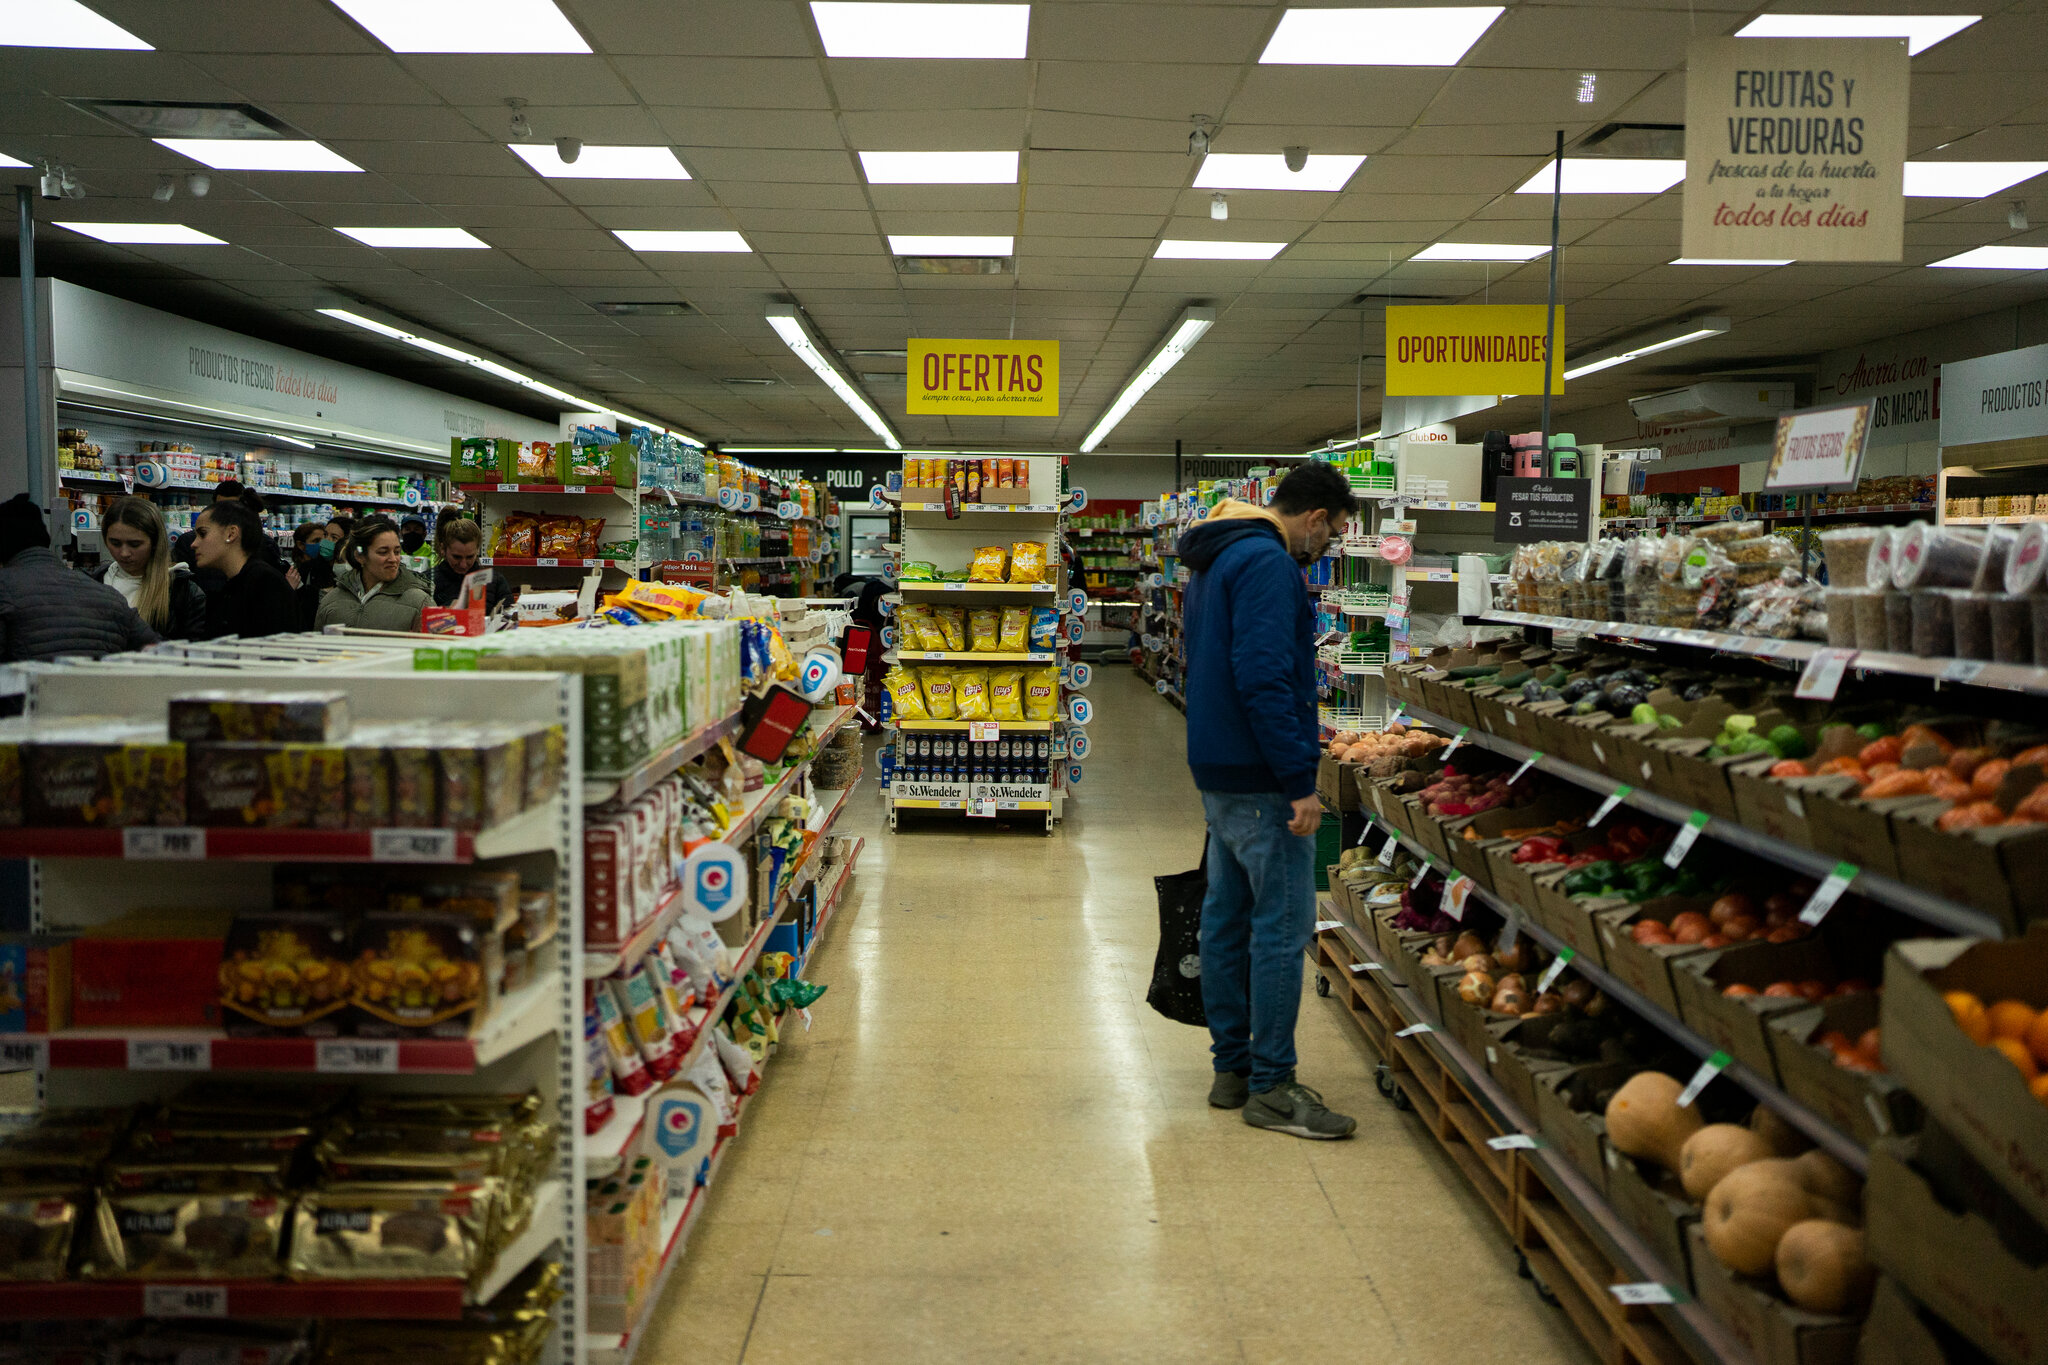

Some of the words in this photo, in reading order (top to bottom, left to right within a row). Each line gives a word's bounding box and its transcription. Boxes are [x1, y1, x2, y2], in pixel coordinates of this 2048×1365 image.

[1735, 70, 1834, 108] FRUTAS
[1842, 78, 1855, 108] Y
[1728, 117, 1864, 155] VERDURAS
[1707, 160, 1768, 185] frescas
[1771, 160, 1794, 178] de
[1797, 160, 1815, 178] la
[1819, 160, 1877, 179] huerta
[1756, 188, 1766, 198] a
[1770, 184, 1784, 198] tu
[1787, 184, 1832, 203] hogar
[1713, 202, 1776, 227] todos
[1780, 202, 1812, 227] los
[1817, 202, 1869, 228] días
[189, 346, 239, 384] PRODUCTOS
[240, 358, 274, 392] FRESCOS
[275, 364, 302, 397] todos
[302, 371, 316, 400] los
[923, 352, 1043, 392] OFERTAS
[1837, 352, 1898, 395] Ahorrá
[1901, 356, 1928, 381] con
[921, 393, 950, 403] siempre
[996, 394, 1026, 402] ahorrar
[1891, 388, 1929, 426] MARCA
[1981, 380, 2041, 414] PRODUCTOS
[826, 469, 863, 488] POLLO
[1511, 492, 1529, 501] PESAR
[1530, 493, 1541, 501] TUS
[1541, 493, 1574, 502] PRODUCTOS
